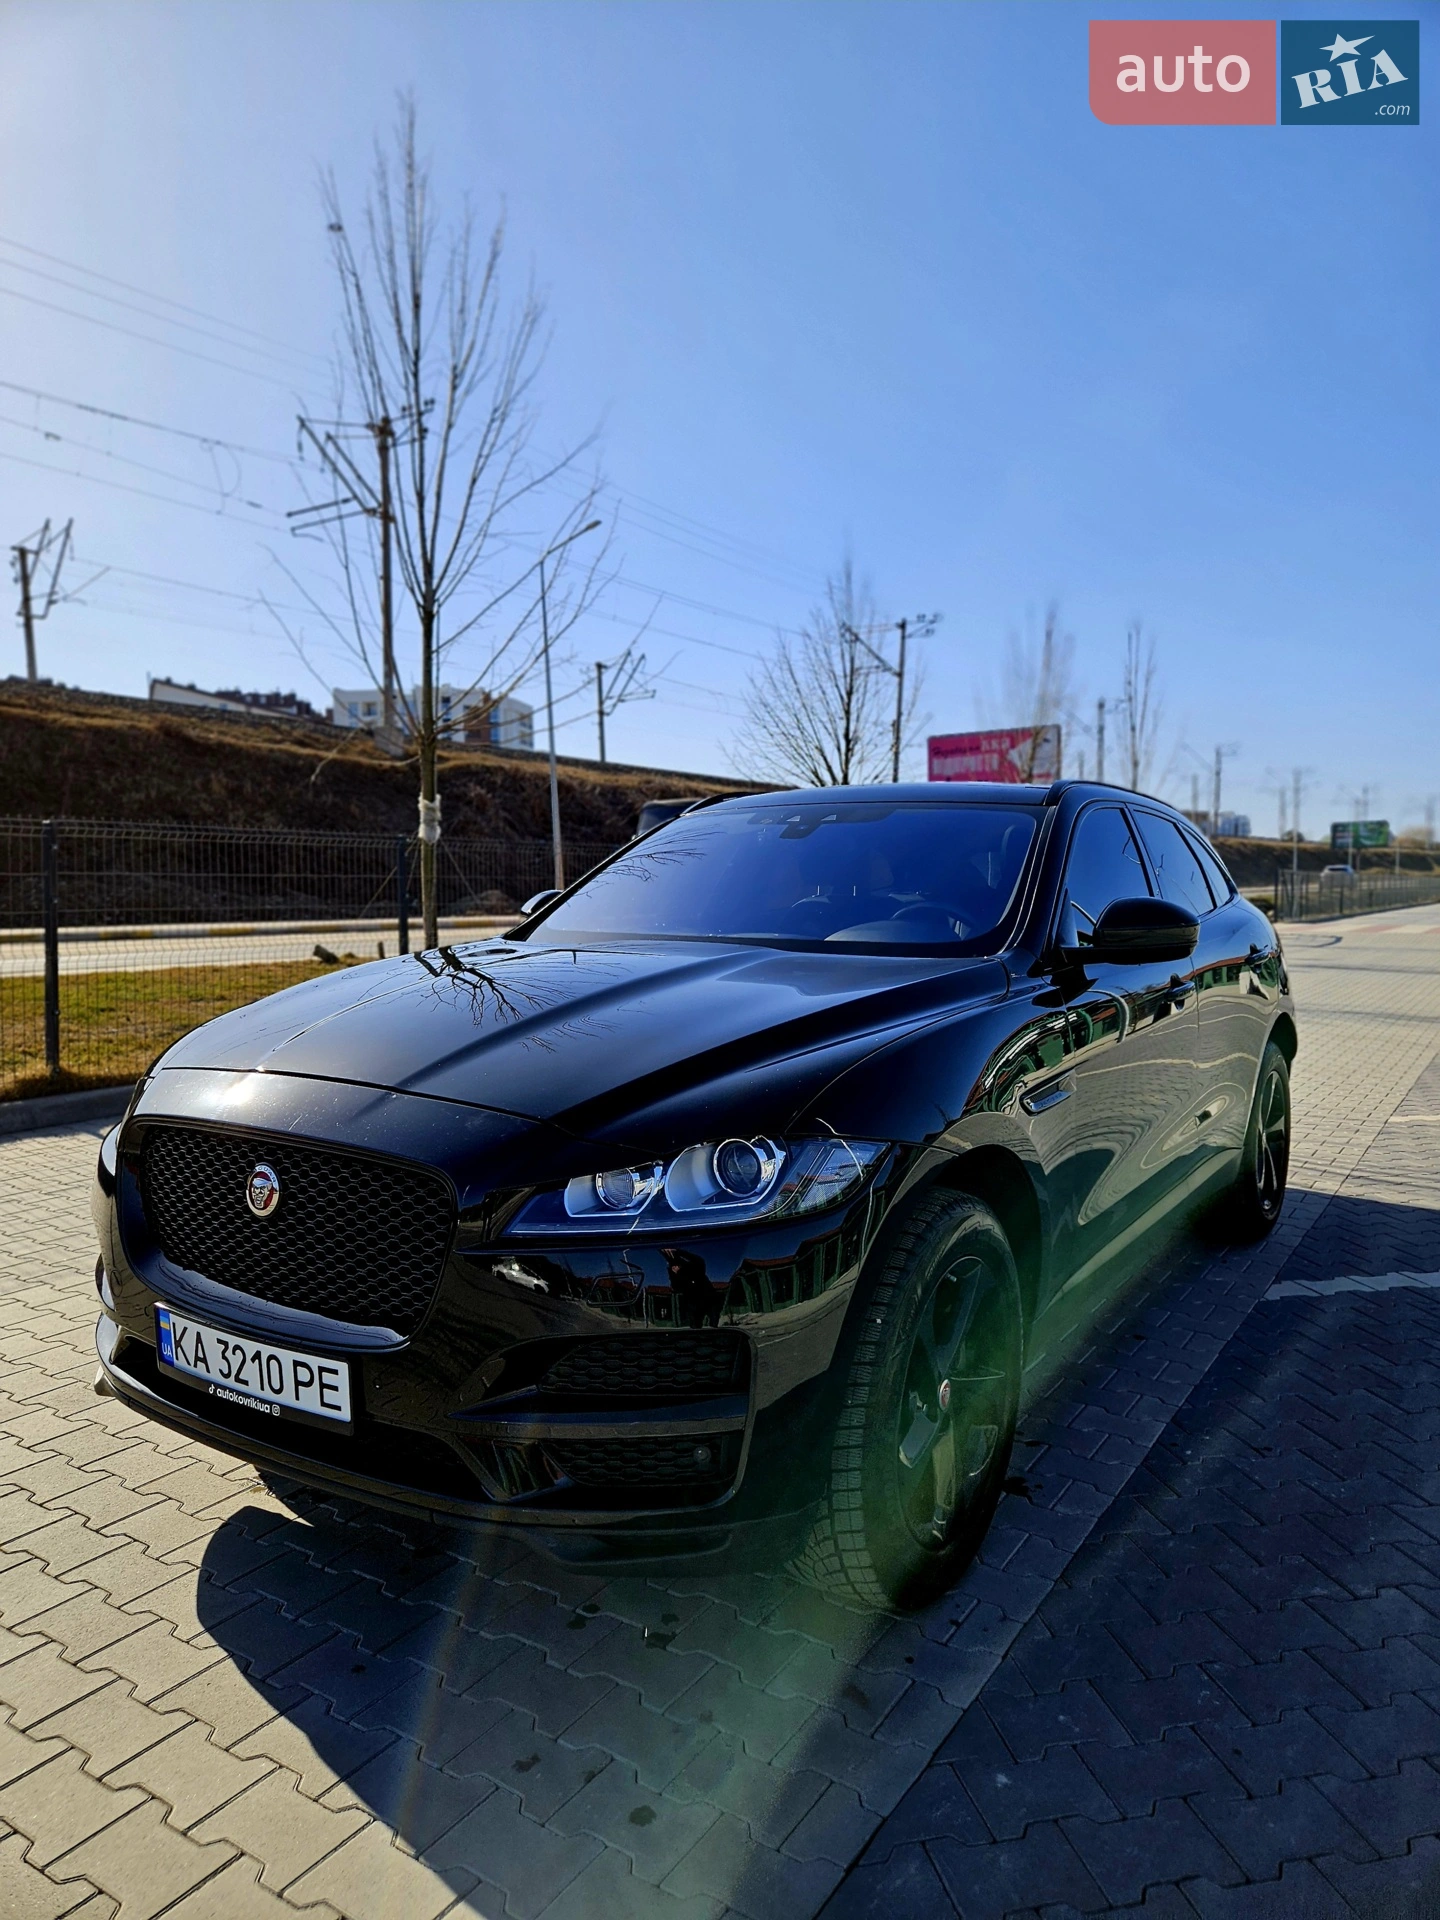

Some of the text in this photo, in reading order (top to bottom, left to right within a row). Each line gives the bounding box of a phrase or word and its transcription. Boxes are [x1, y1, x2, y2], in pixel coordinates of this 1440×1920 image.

[162, 1343, 173, 1358] UA
[172, 1321, 342, 1412] KA 3210 PE
